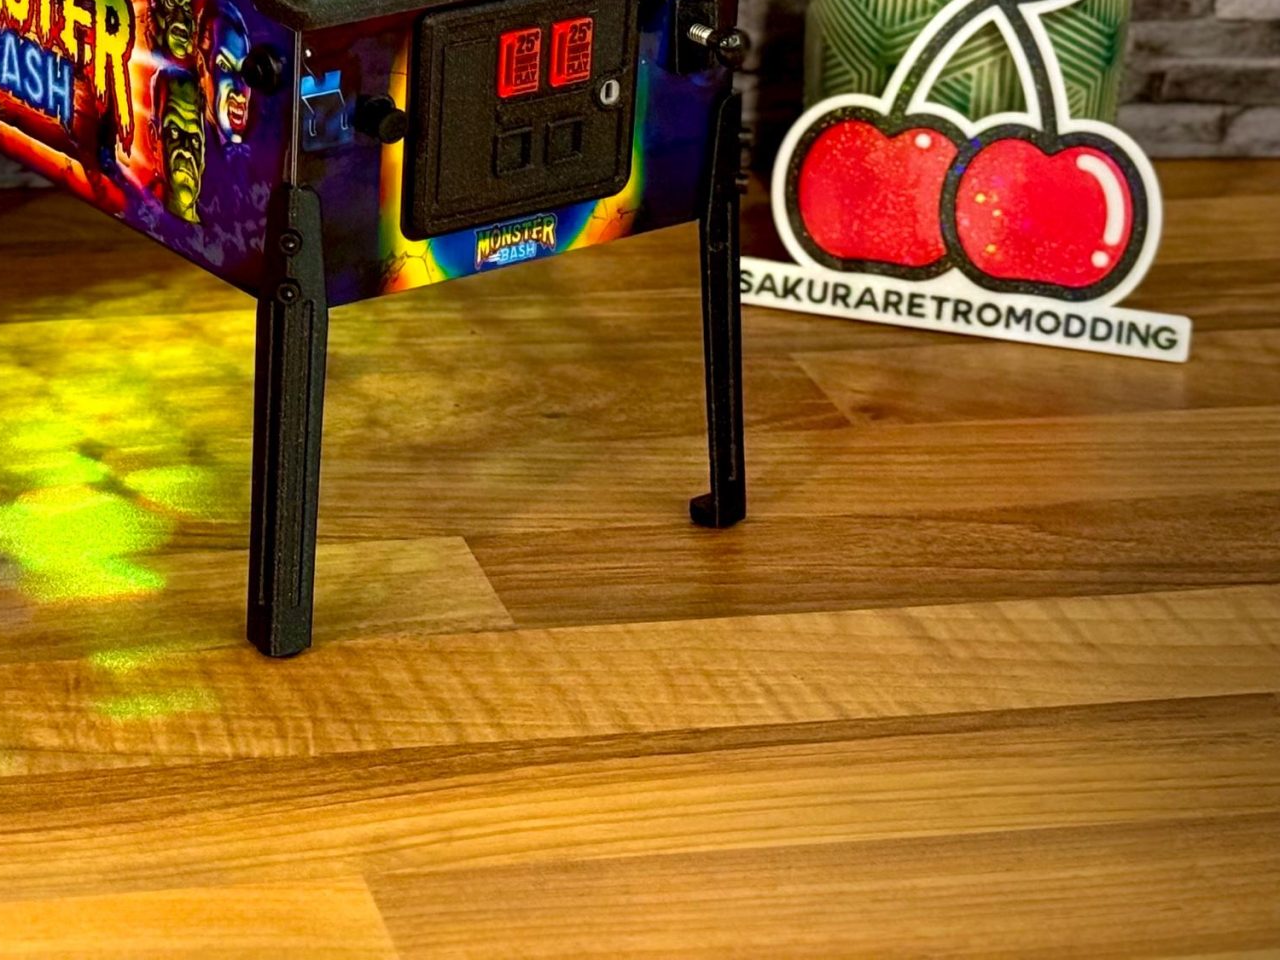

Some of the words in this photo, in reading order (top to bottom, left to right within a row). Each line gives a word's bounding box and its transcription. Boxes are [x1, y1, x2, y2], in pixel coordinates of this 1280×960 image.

[477, 215, 555, 266] MONSTER
[500, 243, 536, 262] BASH
[739, 269, 1178, 351] SAKURARETROMODDING
